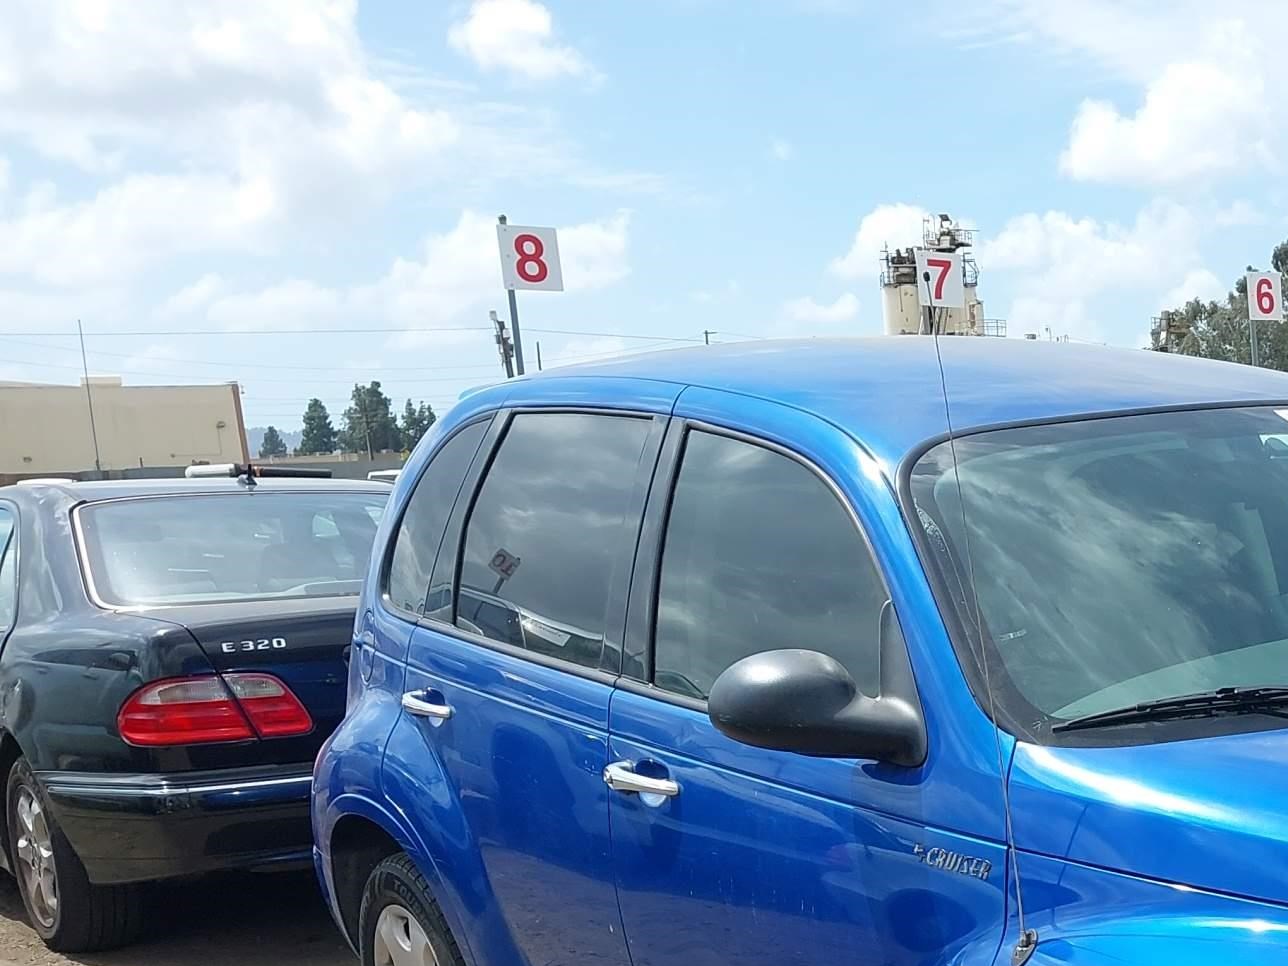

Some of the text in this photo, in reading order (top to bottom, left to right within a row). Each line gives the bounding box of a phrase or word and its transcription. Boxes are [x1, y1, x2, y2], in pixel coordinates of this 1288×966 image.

[514, 234, 548, 283] 8
[926, 258, 952, 300] 7
[1256, 278, 1275, 315] 6
[926, 847, 993, 881] CRUISER
